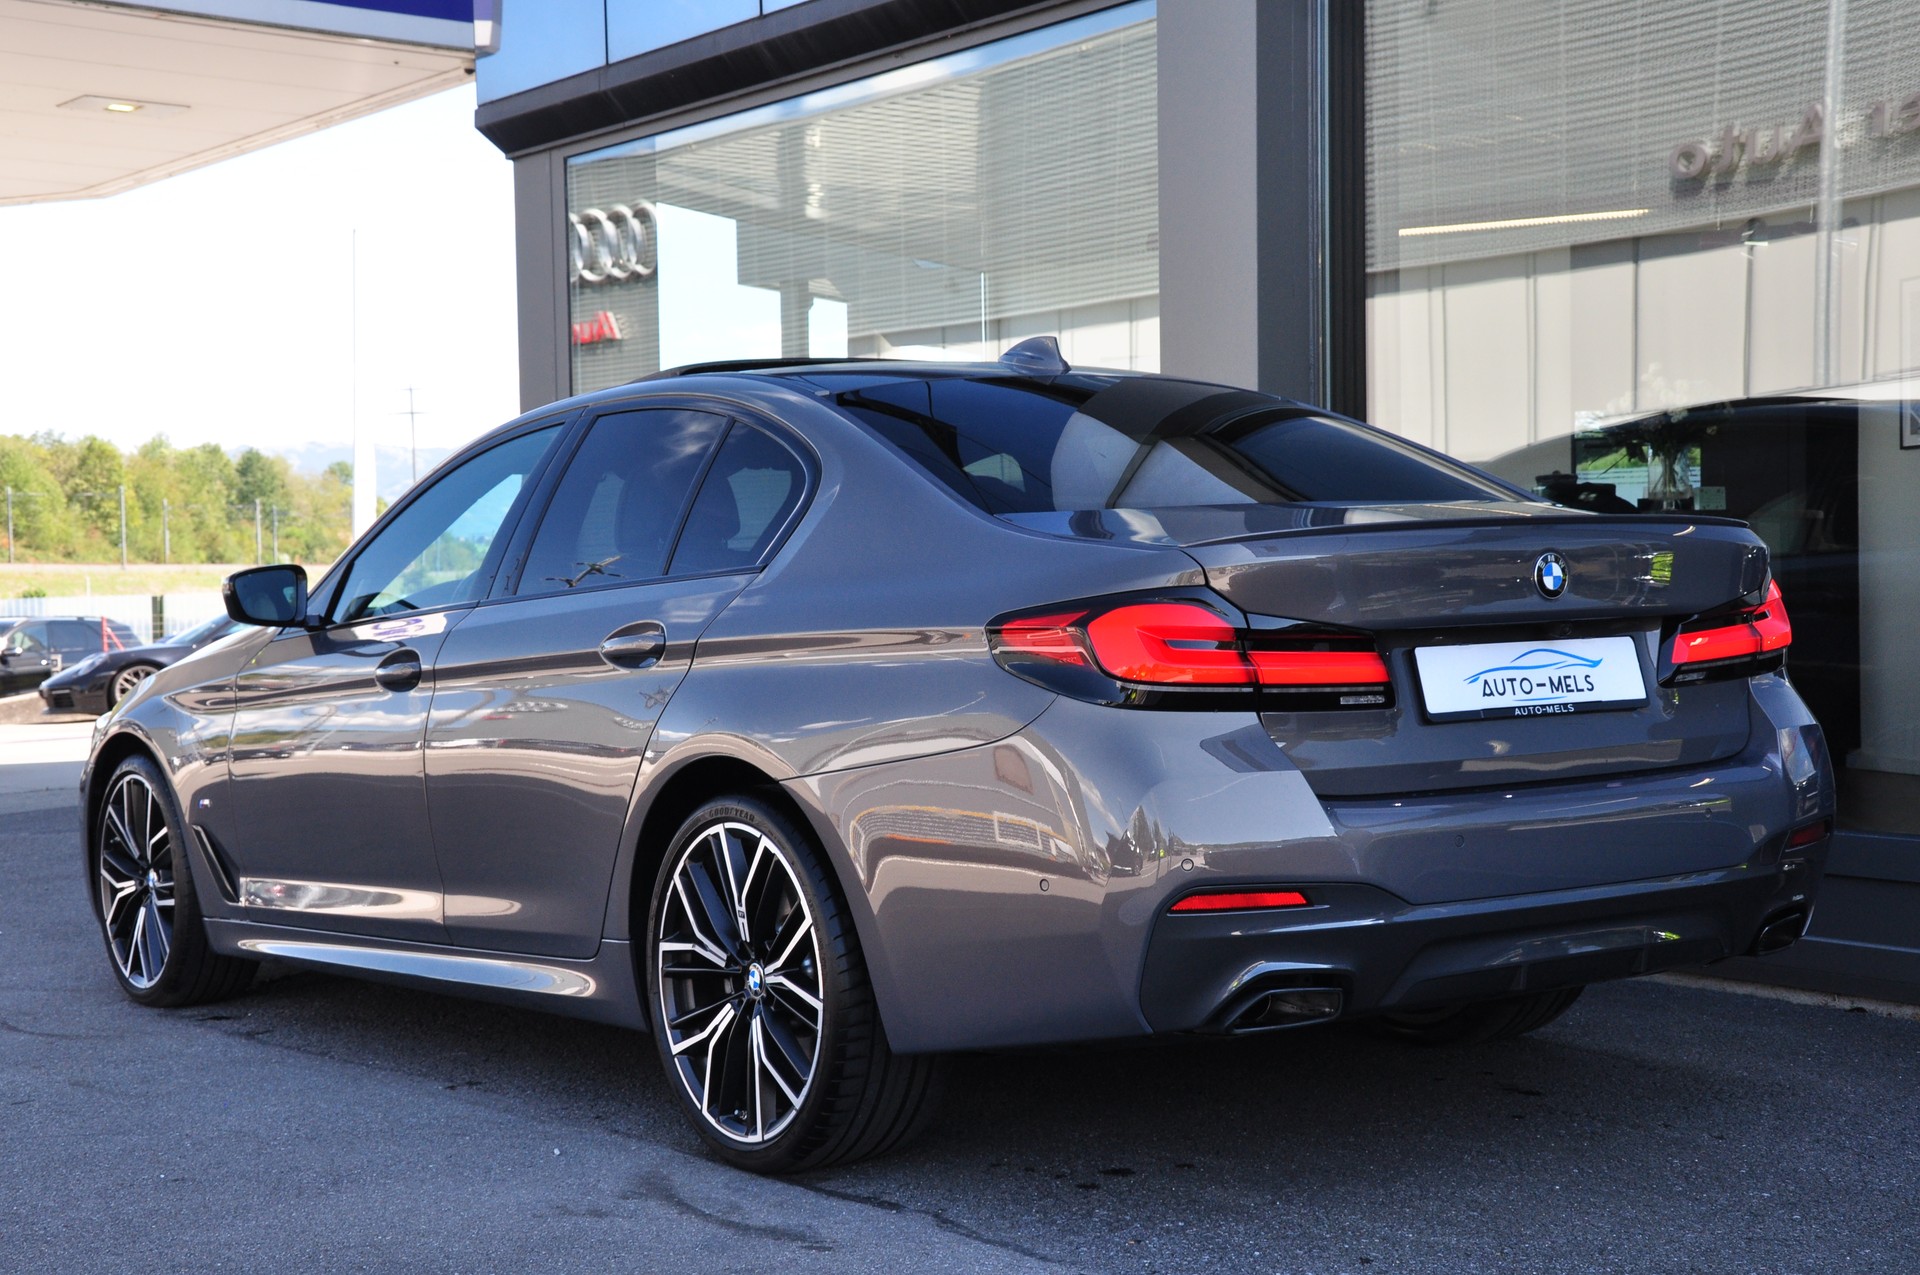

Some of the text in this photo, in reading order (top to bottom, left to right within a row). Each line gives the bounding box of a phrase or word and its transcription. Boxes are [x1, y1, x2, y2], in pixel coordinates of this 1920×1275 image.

[1538, 554, 1566, 569] BMW
[1482, 674, 1595, 697] AUTO-MELS
[1514, 703, 1575, 716] AUTO-MELS
[709, 807, 755, 821] GOODYEAR
